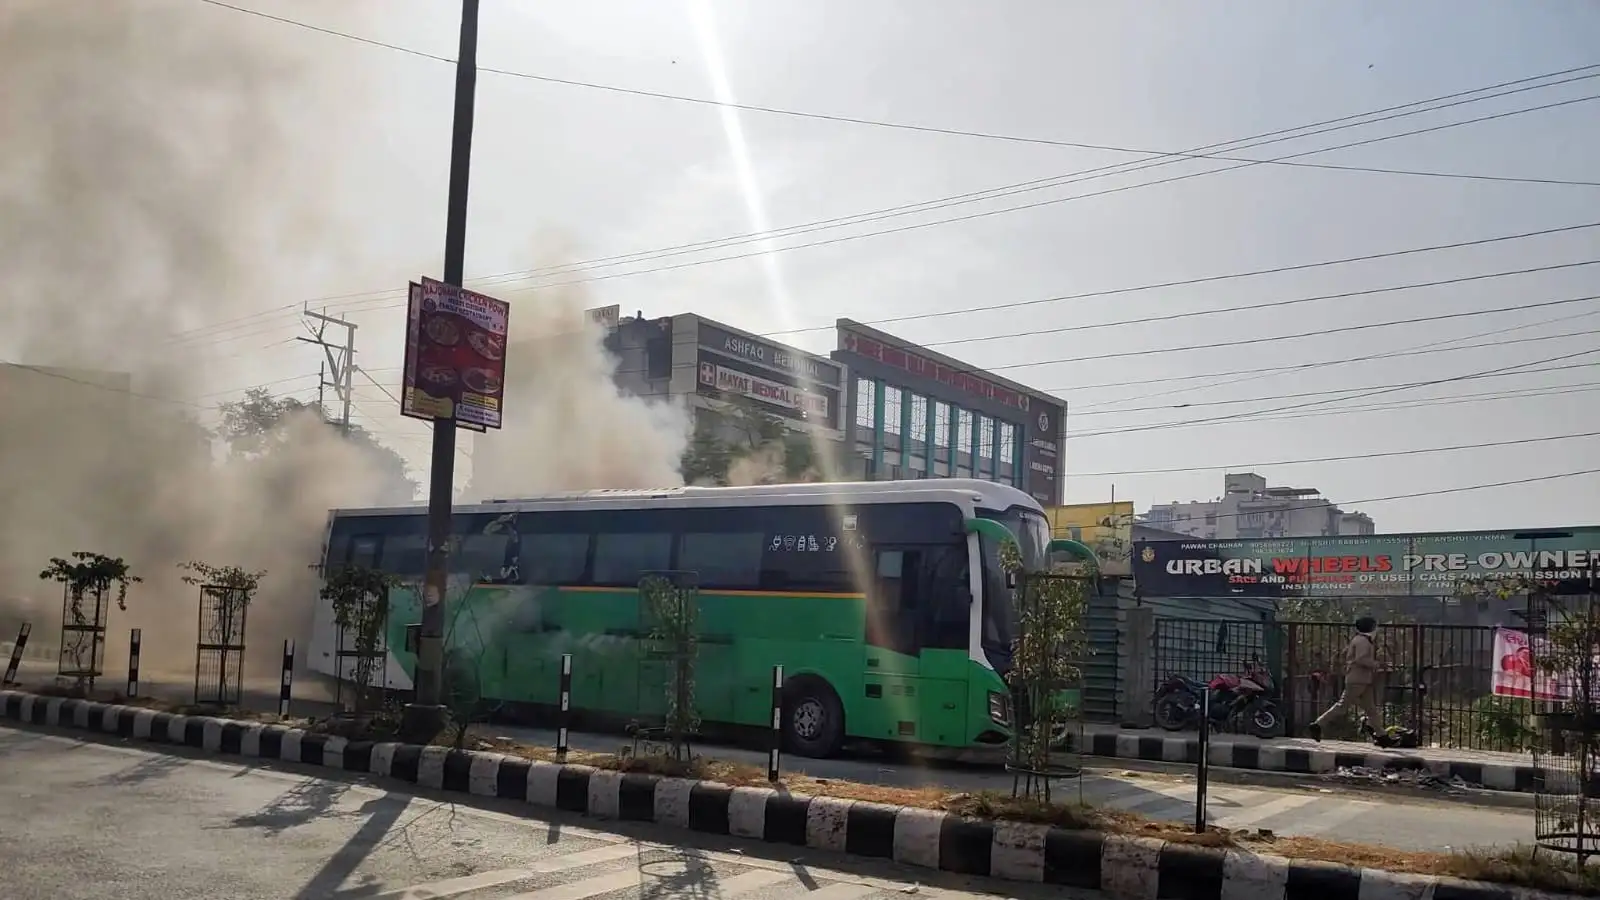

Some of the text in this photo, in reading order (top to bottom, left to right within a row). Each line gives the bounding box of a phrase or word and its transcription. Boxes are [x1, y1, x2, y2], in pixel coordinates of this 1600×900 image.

[724, 336, 764, 361] ASHFAQ
[751, 378, 790, 402] MEDICAL
[1165, 558, 1262, 576] URBAN
[1271, 555, 1392, 573] WHEELS
[1260, 575, 1286, 583] AND
[1359, 573, 1377, 582] OF
[1380, 572, 1415, 581] USED
[1420, 571, 1457, 580] CARS
[1460, 572, 1481, 580] ON
